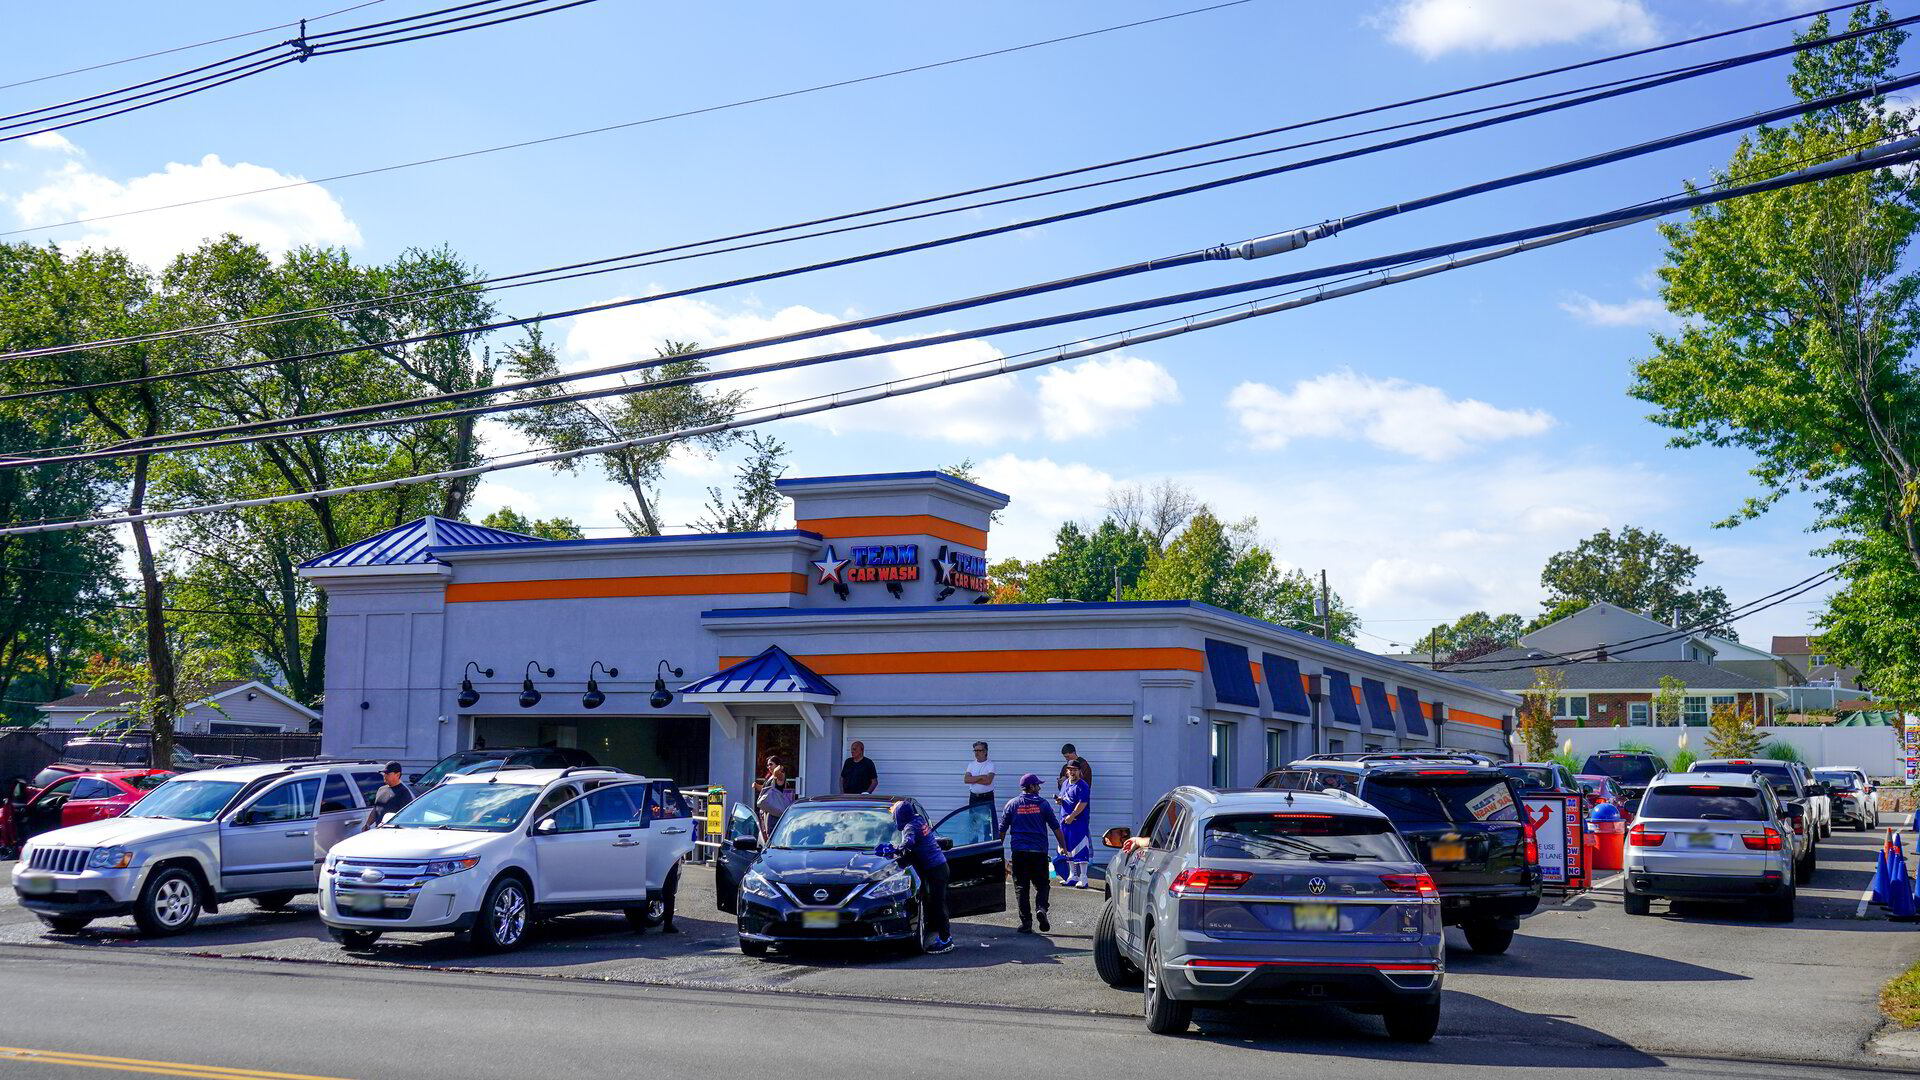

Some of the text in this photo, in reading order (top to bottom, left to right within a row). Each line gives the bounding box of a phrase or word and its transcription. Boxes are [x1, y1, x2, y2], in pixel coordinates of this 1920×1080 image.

[851, 545, 918, 565] TEAM
[955, 552, 986, 577] TEAM
[848, 566, 918, 582] CAR WASH
[955, 573, 969, 589] CAR
